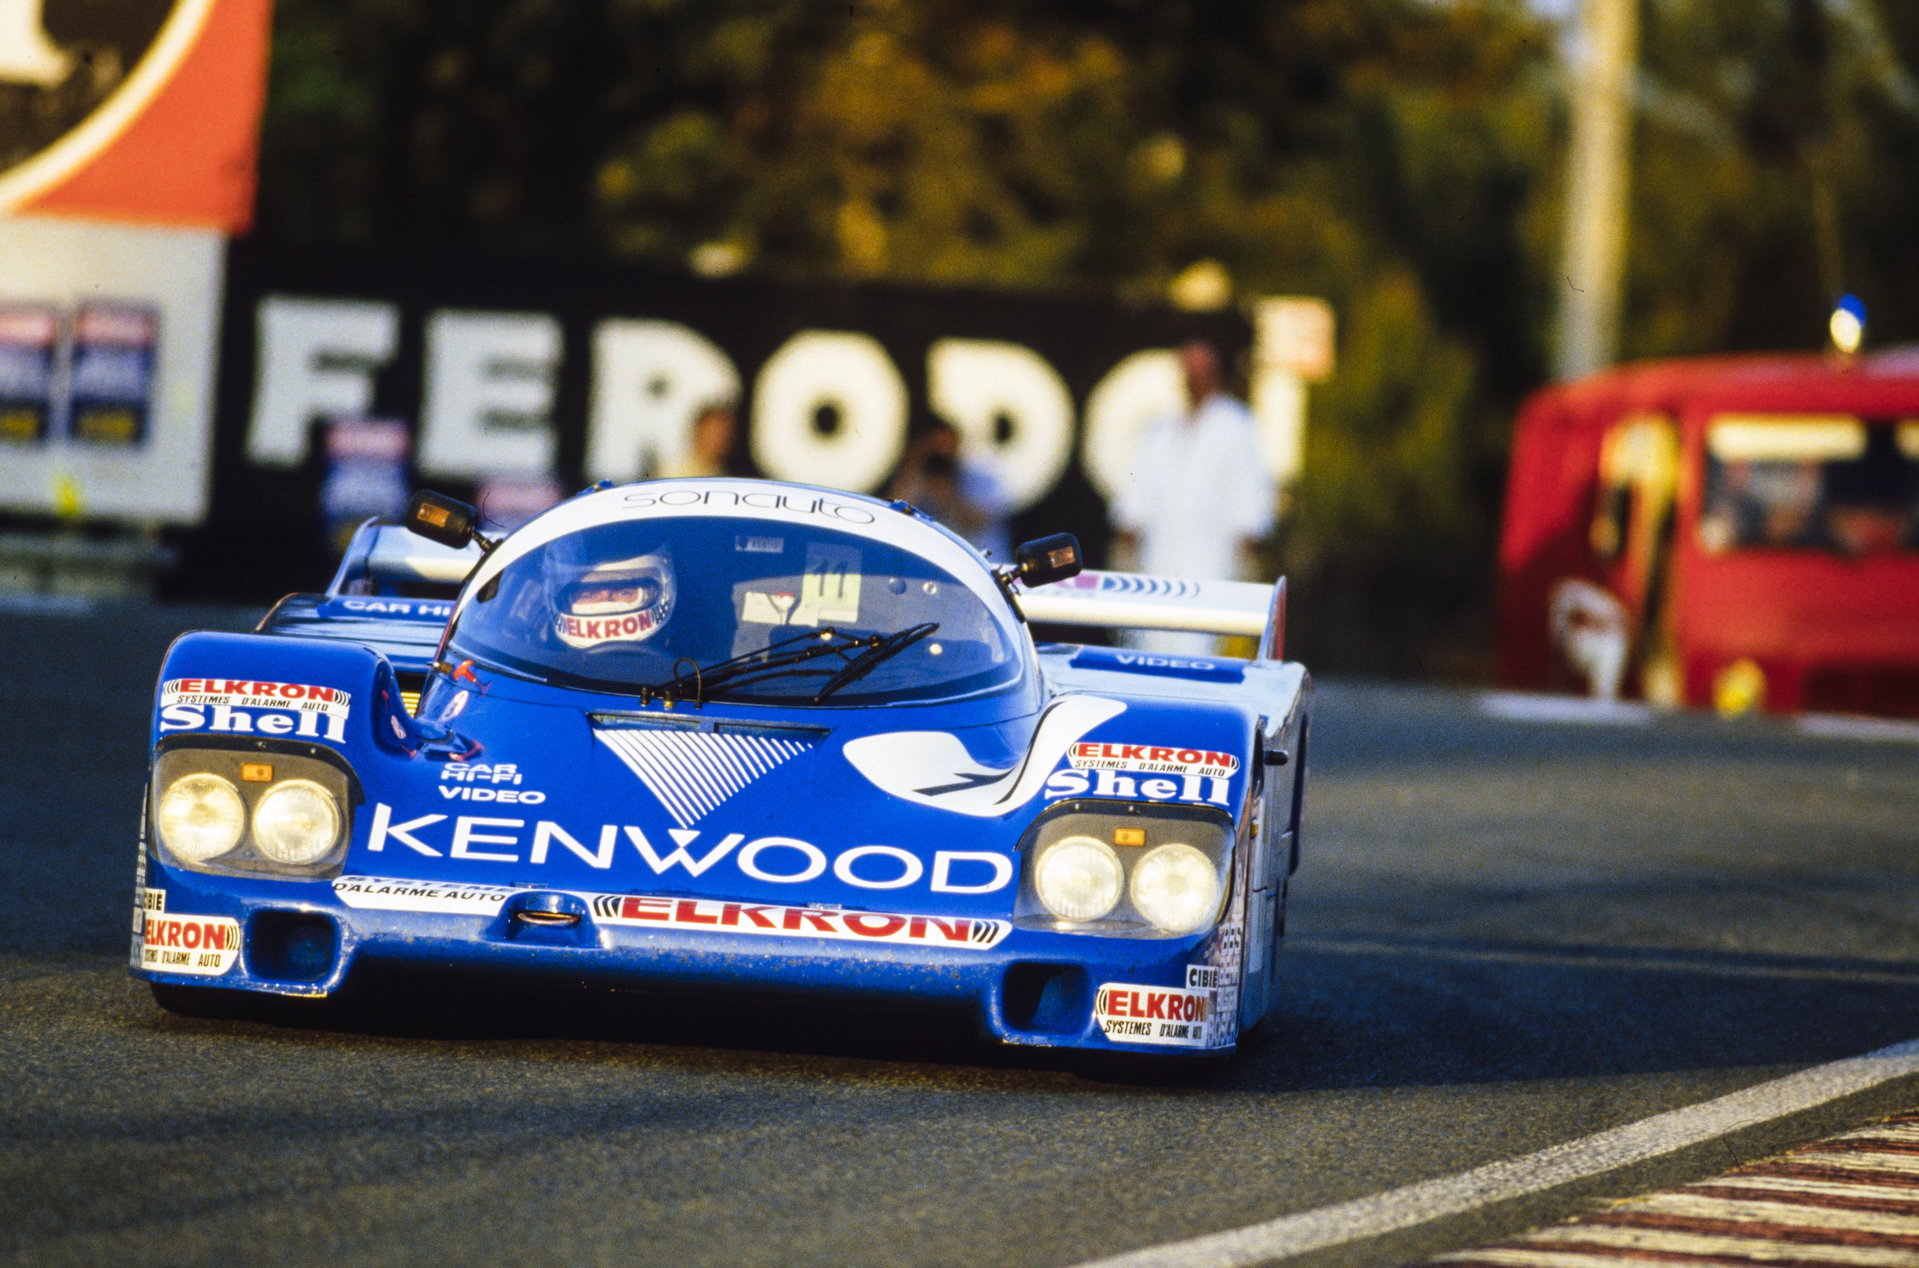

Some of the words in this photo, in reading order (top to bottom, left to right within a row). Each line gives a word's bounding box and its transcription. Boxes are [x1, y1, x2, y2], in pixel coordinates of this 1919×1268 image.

[622, 490, 875, 524] sonauto
[343, 600, 411, 614] CAR
[566, 610, 653, 639] ELKRON
[1114, 654, 1215, 671] VIDEO
[179, 678, 335, 702] ELKRON
[176, 694, 231, 705] SYSTEMES
[241, 697, 292, 709] D'ALARME
[301, 701, 329, 712] AUTO
[160, 703, 346, 744] Shell
[1077, 743, 1232, 768] ELKRON
[441, 769, 522, 785] HI-FI
[444, 762, 518, 774] CAR
[1074, 759, 1129, 769] SYSTEMES
[1138, 762, 1188, 774] D'ALARME
[1198, 767, 1226, 777] AUTO
[438, 785, 546, 804] VIDEO
[1044, 768, 1230, 807] Shell
[367, 802, 1014, 894] KENWOOD
[333, 882, 439, 898] D'ALARME
[444, 890, 507, 902] AUTO
[621, 895, 972, 942] ELKRON
[198, 953, 221, 968] AUTO
[1107, 990, 1207, 1022] ELKRON
[1105, 1020, 1152, 1036] SYSTEMES
